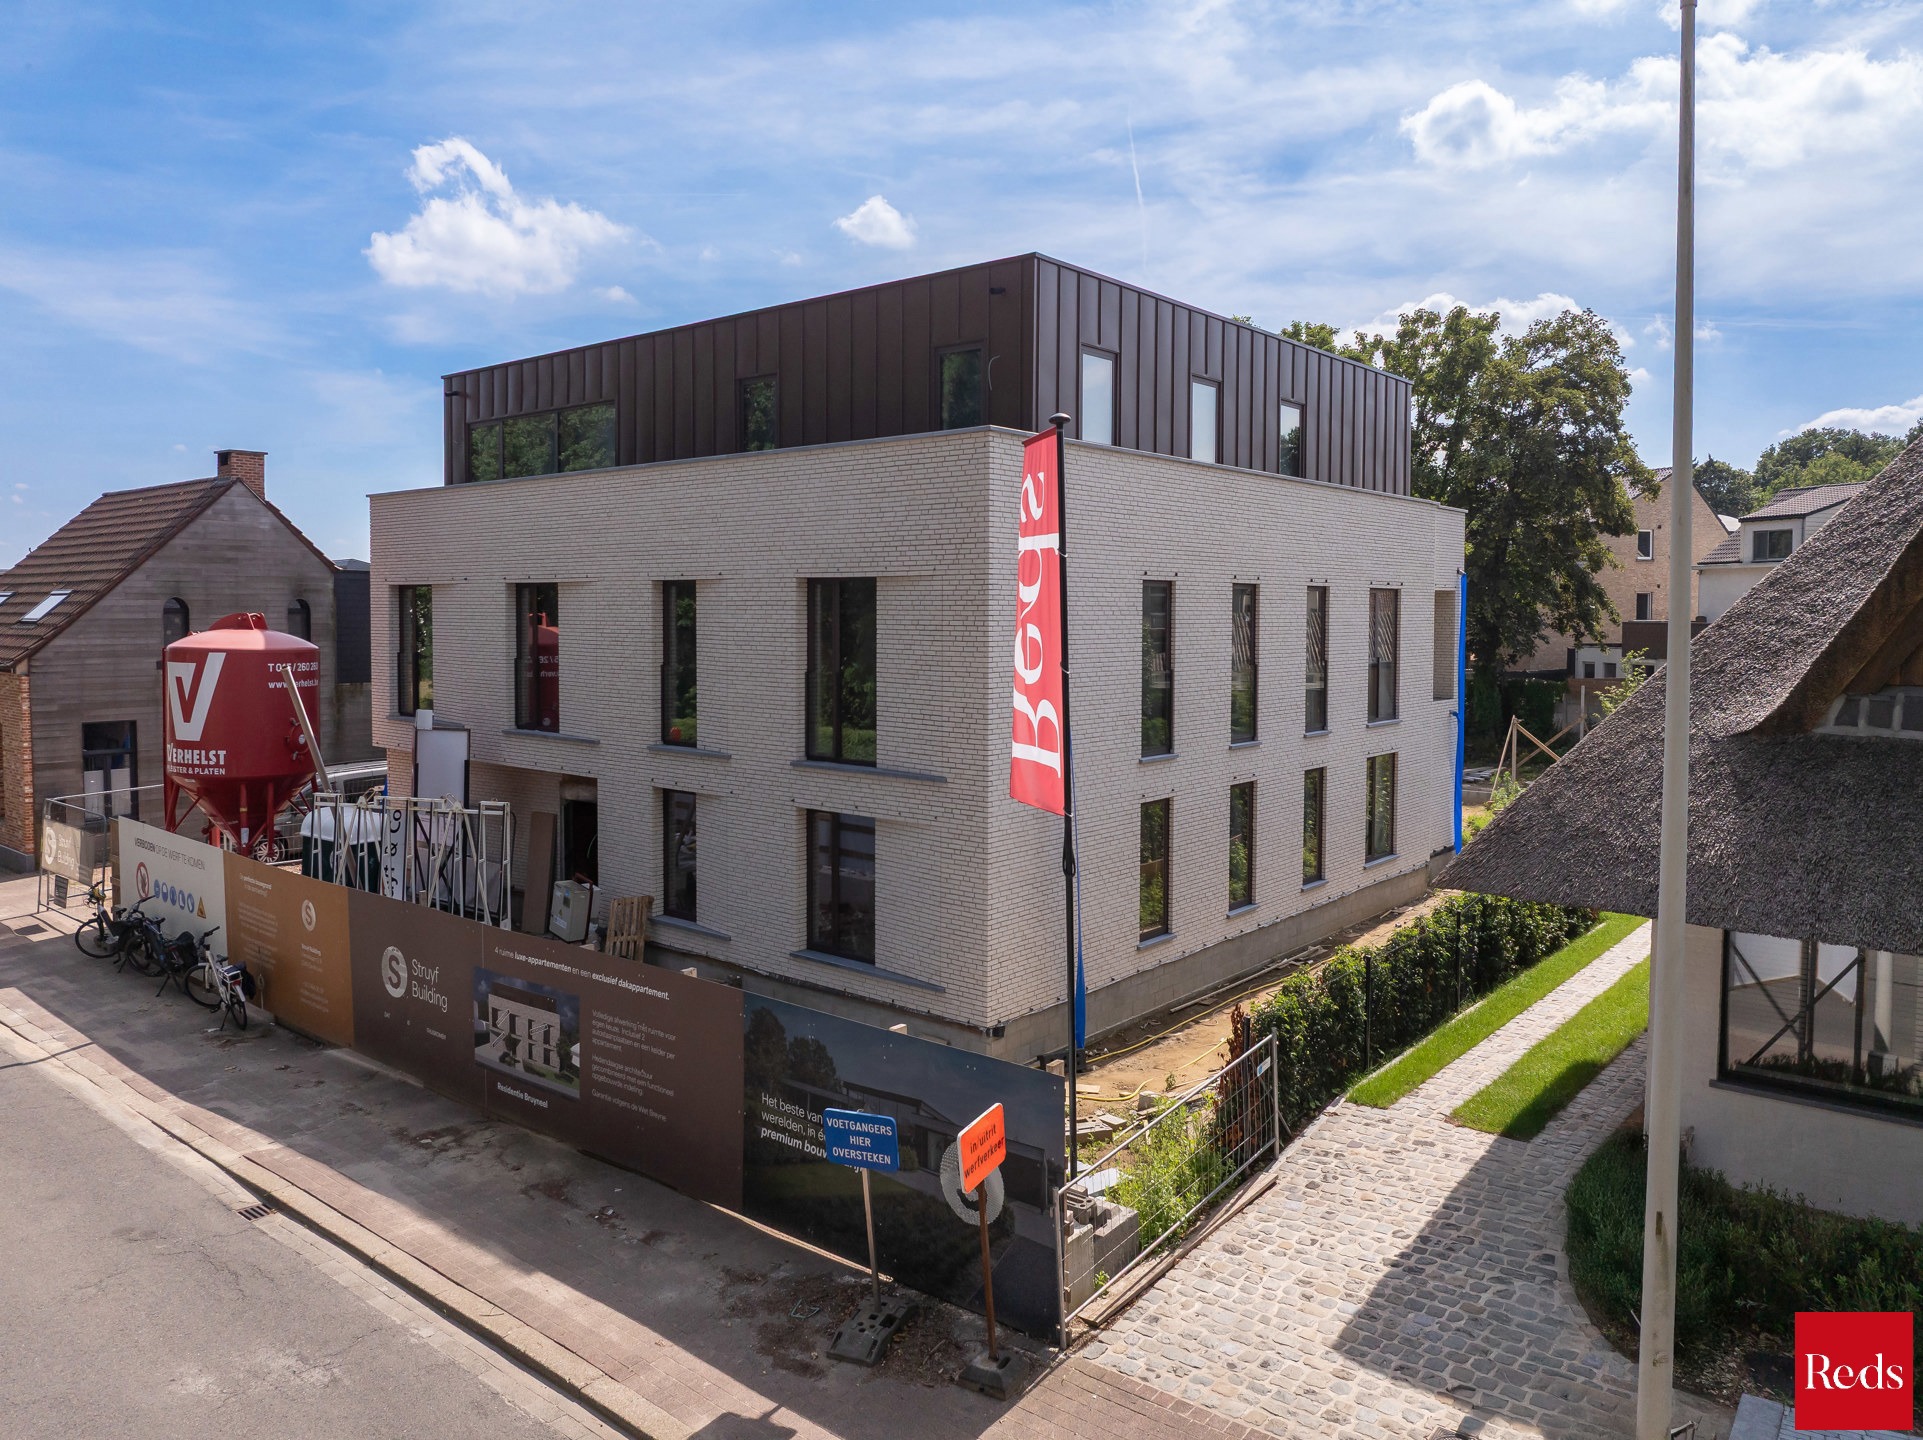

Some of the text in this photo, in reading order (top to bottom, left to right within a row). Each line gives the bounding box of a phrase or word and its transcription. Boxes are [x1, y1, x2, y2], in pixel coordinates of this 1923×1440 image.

[167, 742, 227, 766] VERHELST
[194, 767, 226, 775] PLATEN
[135, 837, 155, 853] VERBODEN
[412, 958, 440, 985] Struyf
[494, 946, 670, 1000] 4 ruime luxe-appartementen en een exclusief dakappartement.
[412, 980, 448, 1013] Building
[497, 1081, 549, 1108] Residentie Bruyneel
[761, 1092, 823, 1124] Het beste van
[761, 1110, 806, 1136] werelden,
[807, 1123, 816, 1139] in
[826, 1117, 893, 1136] VOETGANGERS
[760, 1127, 803, 1150] premium
[849, 1135, 872, 1148] HIER
[832, 1146, 891, 1165] OVERSTEKEN
[964, 1136, 1005, 1179] werfverkeer
